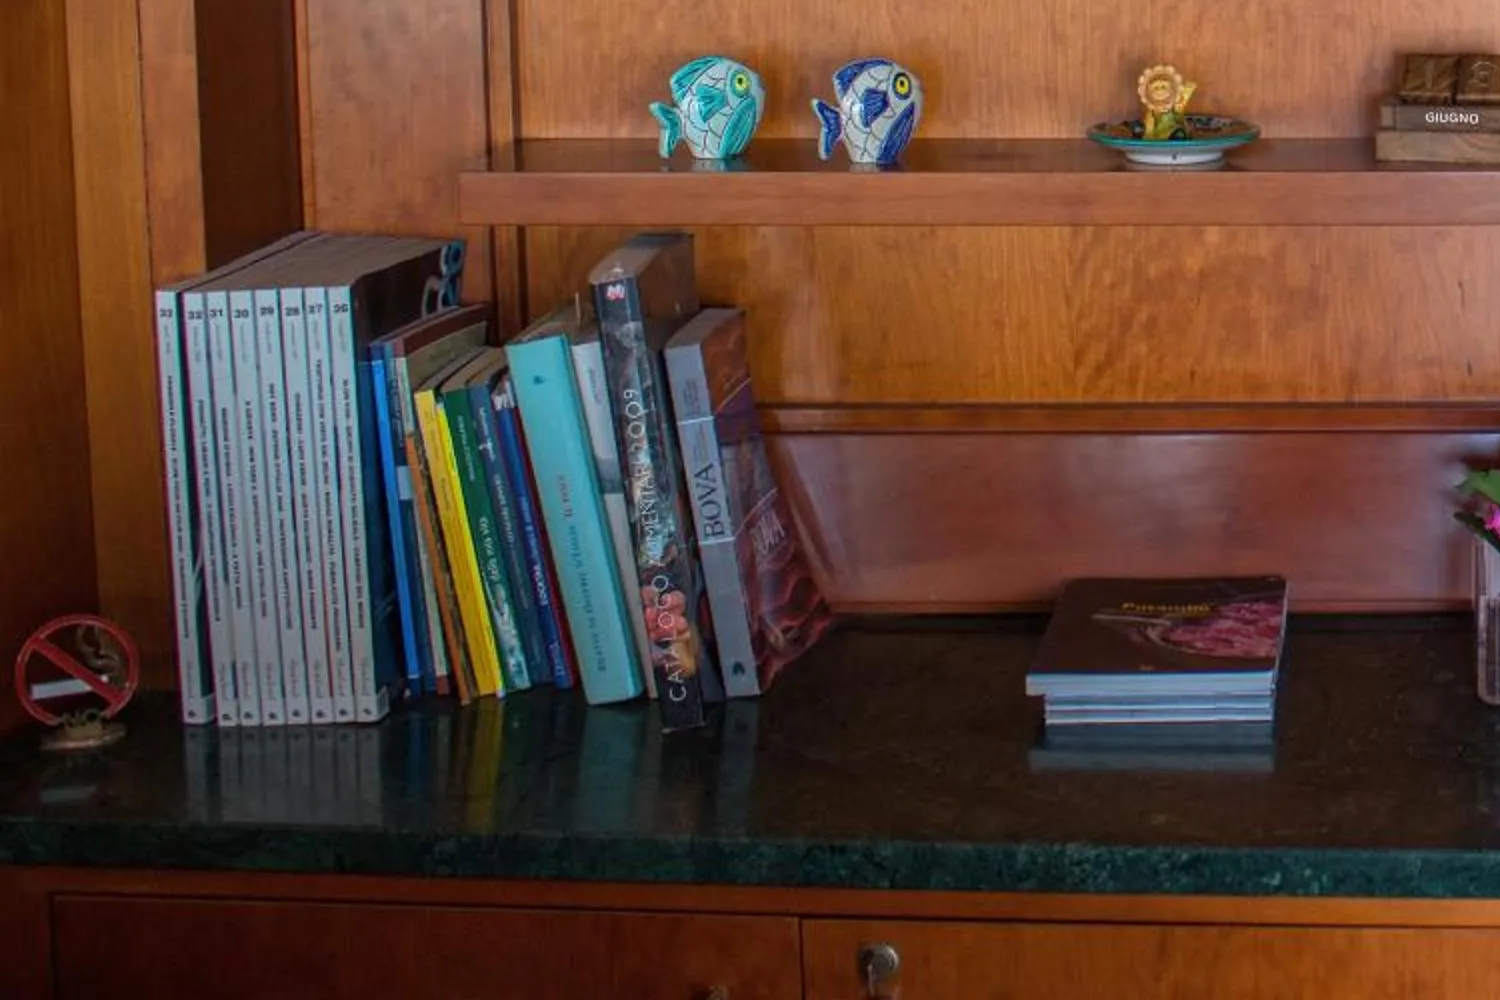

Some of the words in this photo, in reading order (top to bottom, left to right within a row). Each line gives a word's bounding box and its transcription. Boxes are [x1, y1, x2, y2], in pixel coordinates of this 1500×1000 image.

[1424, 112, 1479, 125] GIUGNO
[623, 388, 645, 450] 2009
[693, 462, 725, 538] BOVA
[651, 574, 688, 702] CATALOGO
